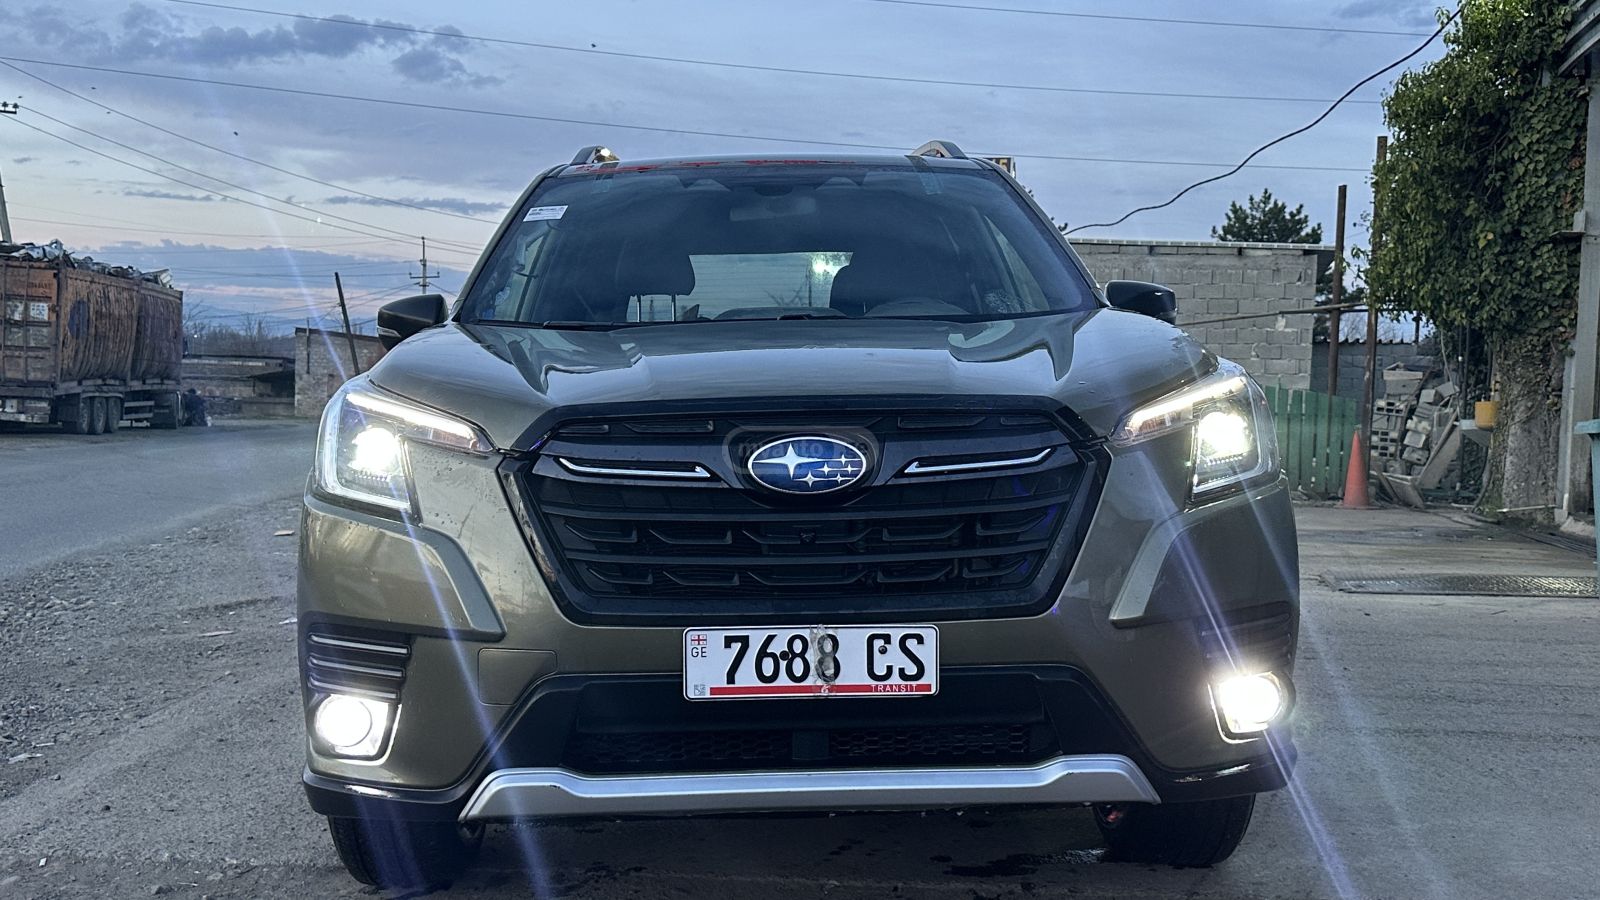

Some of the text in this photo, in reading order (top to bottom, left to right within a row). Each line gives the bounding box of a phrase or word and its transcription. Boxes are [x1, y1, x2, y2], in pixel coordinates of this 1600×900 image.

[691, 647, 707, 658] GE
[724, 632, 926, 684] 7688 CS
[871, 684, 918, 693] TRANSIT
